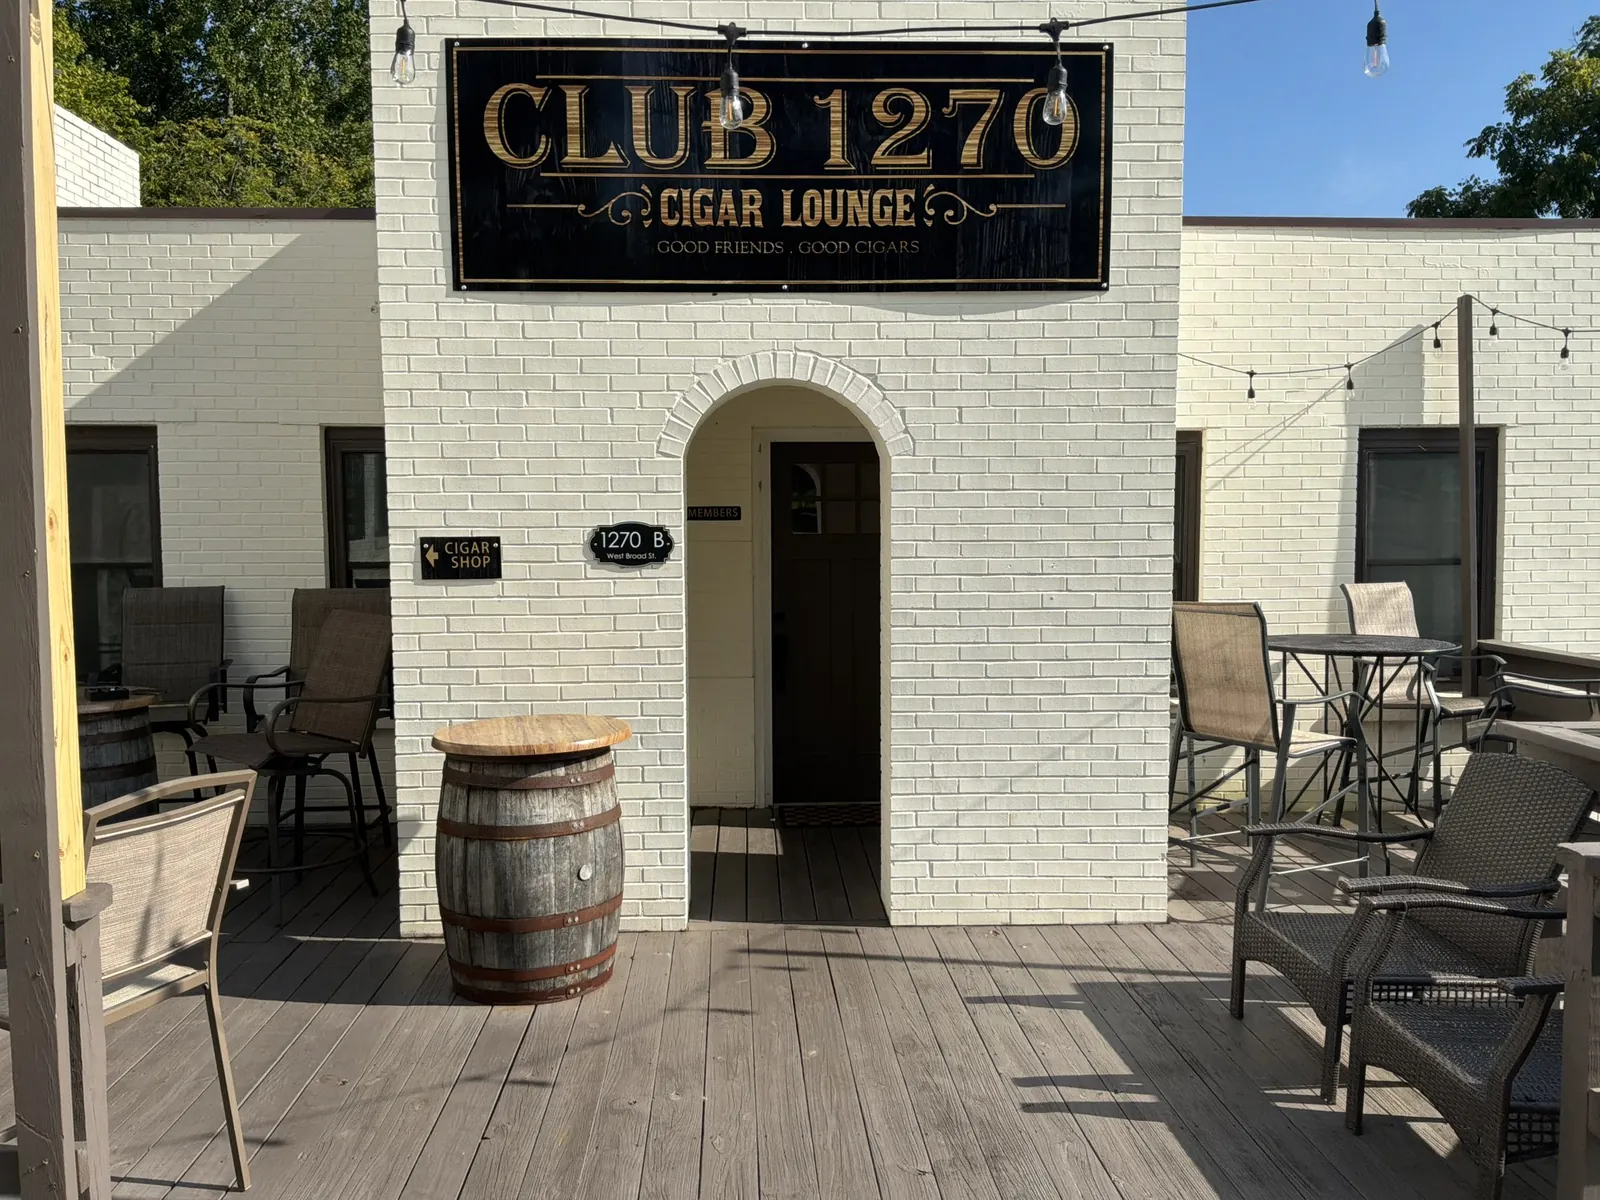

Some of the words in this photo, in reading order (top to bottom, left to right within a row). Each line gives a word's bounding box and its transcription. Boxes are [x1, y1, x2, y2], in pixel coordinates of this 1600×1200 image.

[483, 82, 776, 170] CLUB
[813, 86, 1082, 170] 1270
[660, 187, 765, 229] CIGAR
[781, 187, 917, 229] LOUNGE
[657, 240, 709, 255] GOOD
[714, 240, 785, 255] FRIENDS
[798, 240, 850, 255] GOOD
[854, 240, 920, 255] CIGARS
[688, 507, 738, 518] MEMBERS
[600, 531, 642, 549] 1270
[653, 531, 665, 548] B
[444, 541, 490, 554] CIGAR
[451, 555, 491, 569] SHOP
[606, 552, 624, 560] West
[625, 552, 647, 560] Broad
[648, 552, 657, 560] St.
